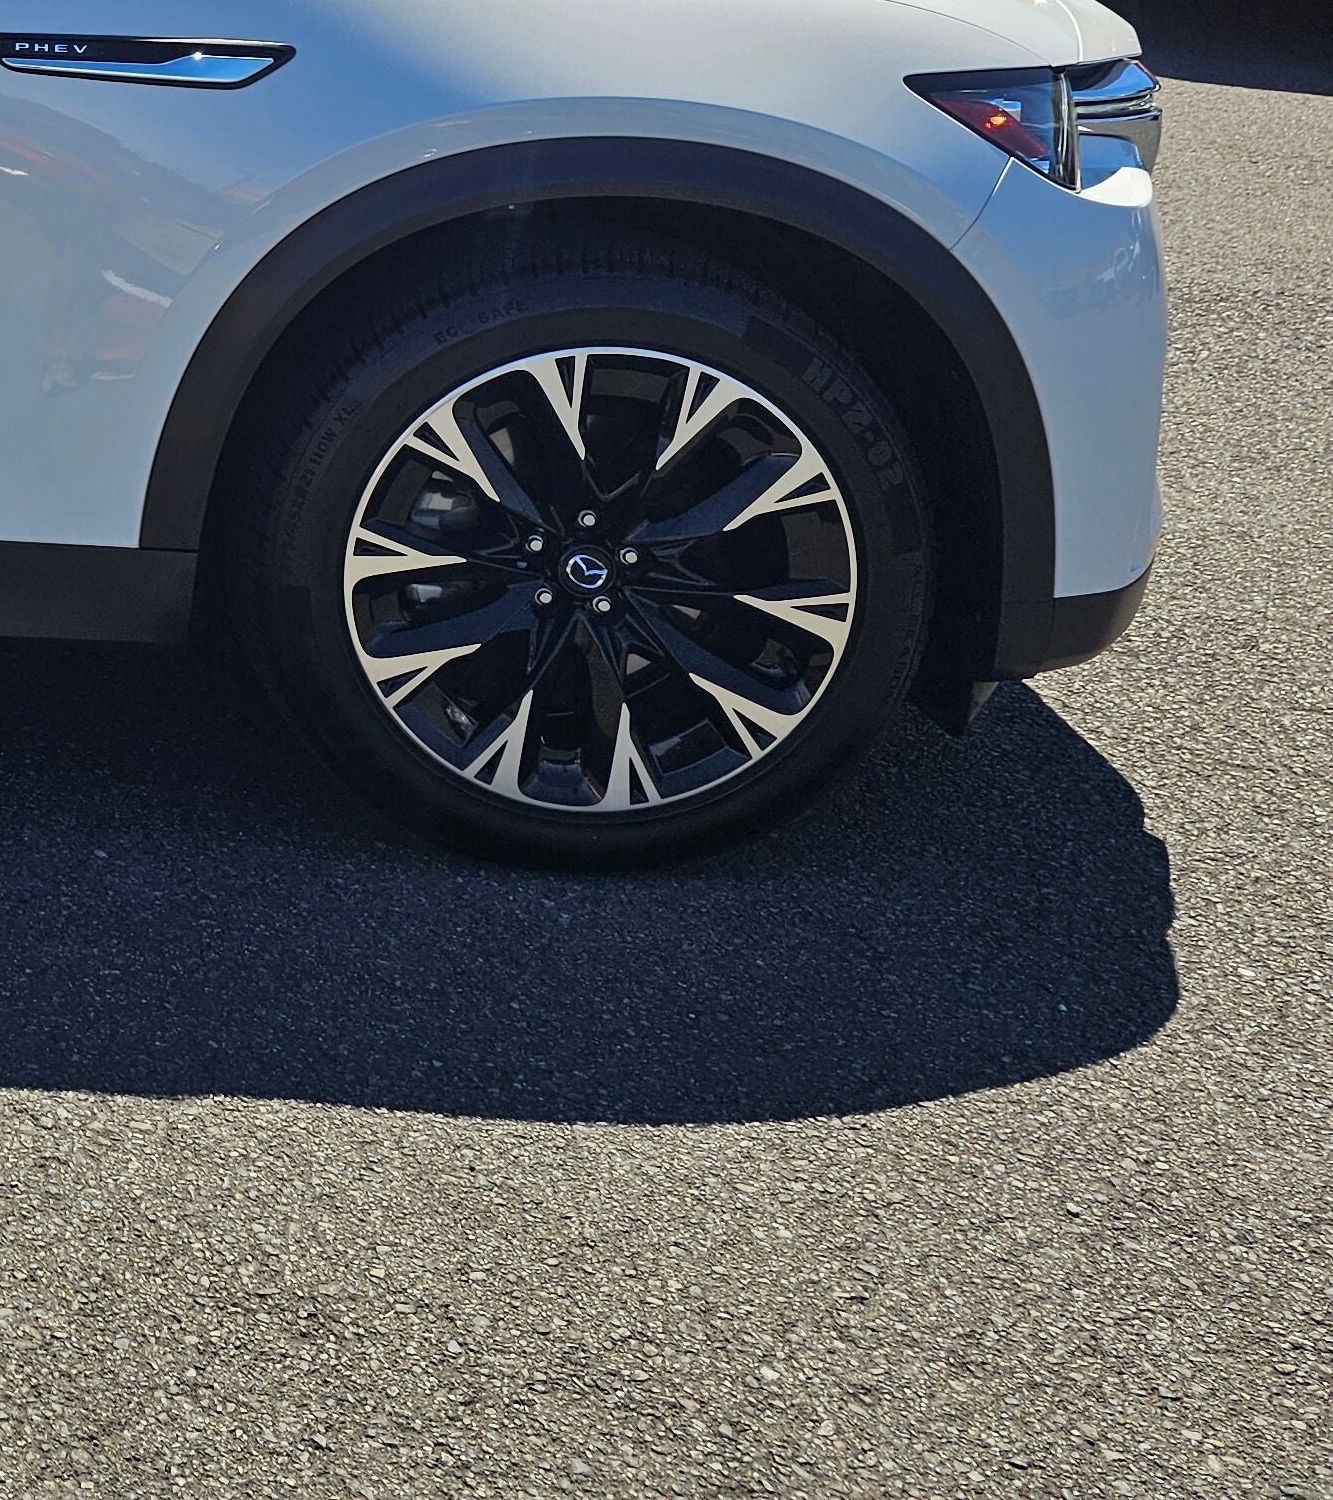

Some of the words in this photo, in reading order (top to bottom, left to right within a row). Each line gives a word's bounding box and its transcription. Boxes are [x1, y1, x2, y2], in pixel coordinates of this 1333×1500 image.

[14, 42, 89, 54] PHEV
[476, 298, 528, 324] SAFE
[307, 427, 338, 466] 110W
[333, 402, 356, 426] XL
